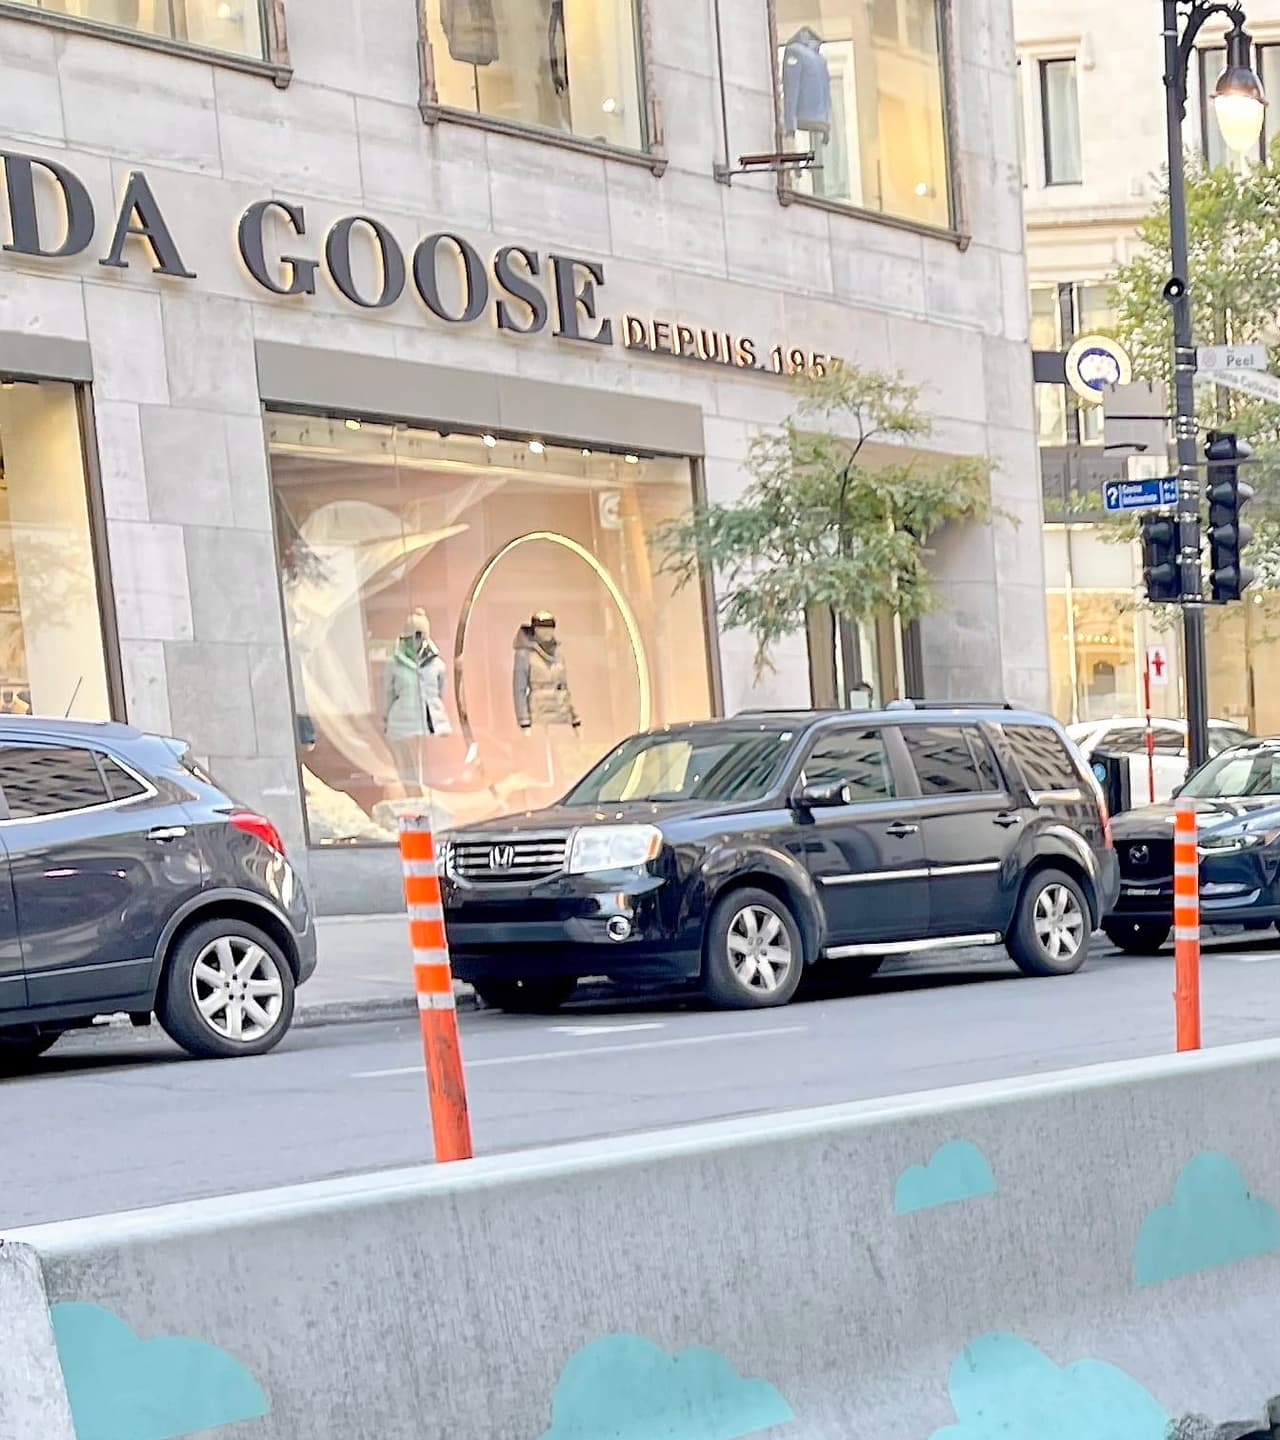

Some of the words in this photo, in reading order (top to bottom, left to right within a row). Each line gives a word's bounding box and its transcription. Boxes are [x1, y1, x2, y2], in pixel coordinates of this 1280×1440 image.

[0, 152, 197, 279] DA
[237, 199, 614, 346] GOOSE
[621, 313, 757, 368] DEPUIS
[1226, 354, 1254, 367] Peel
